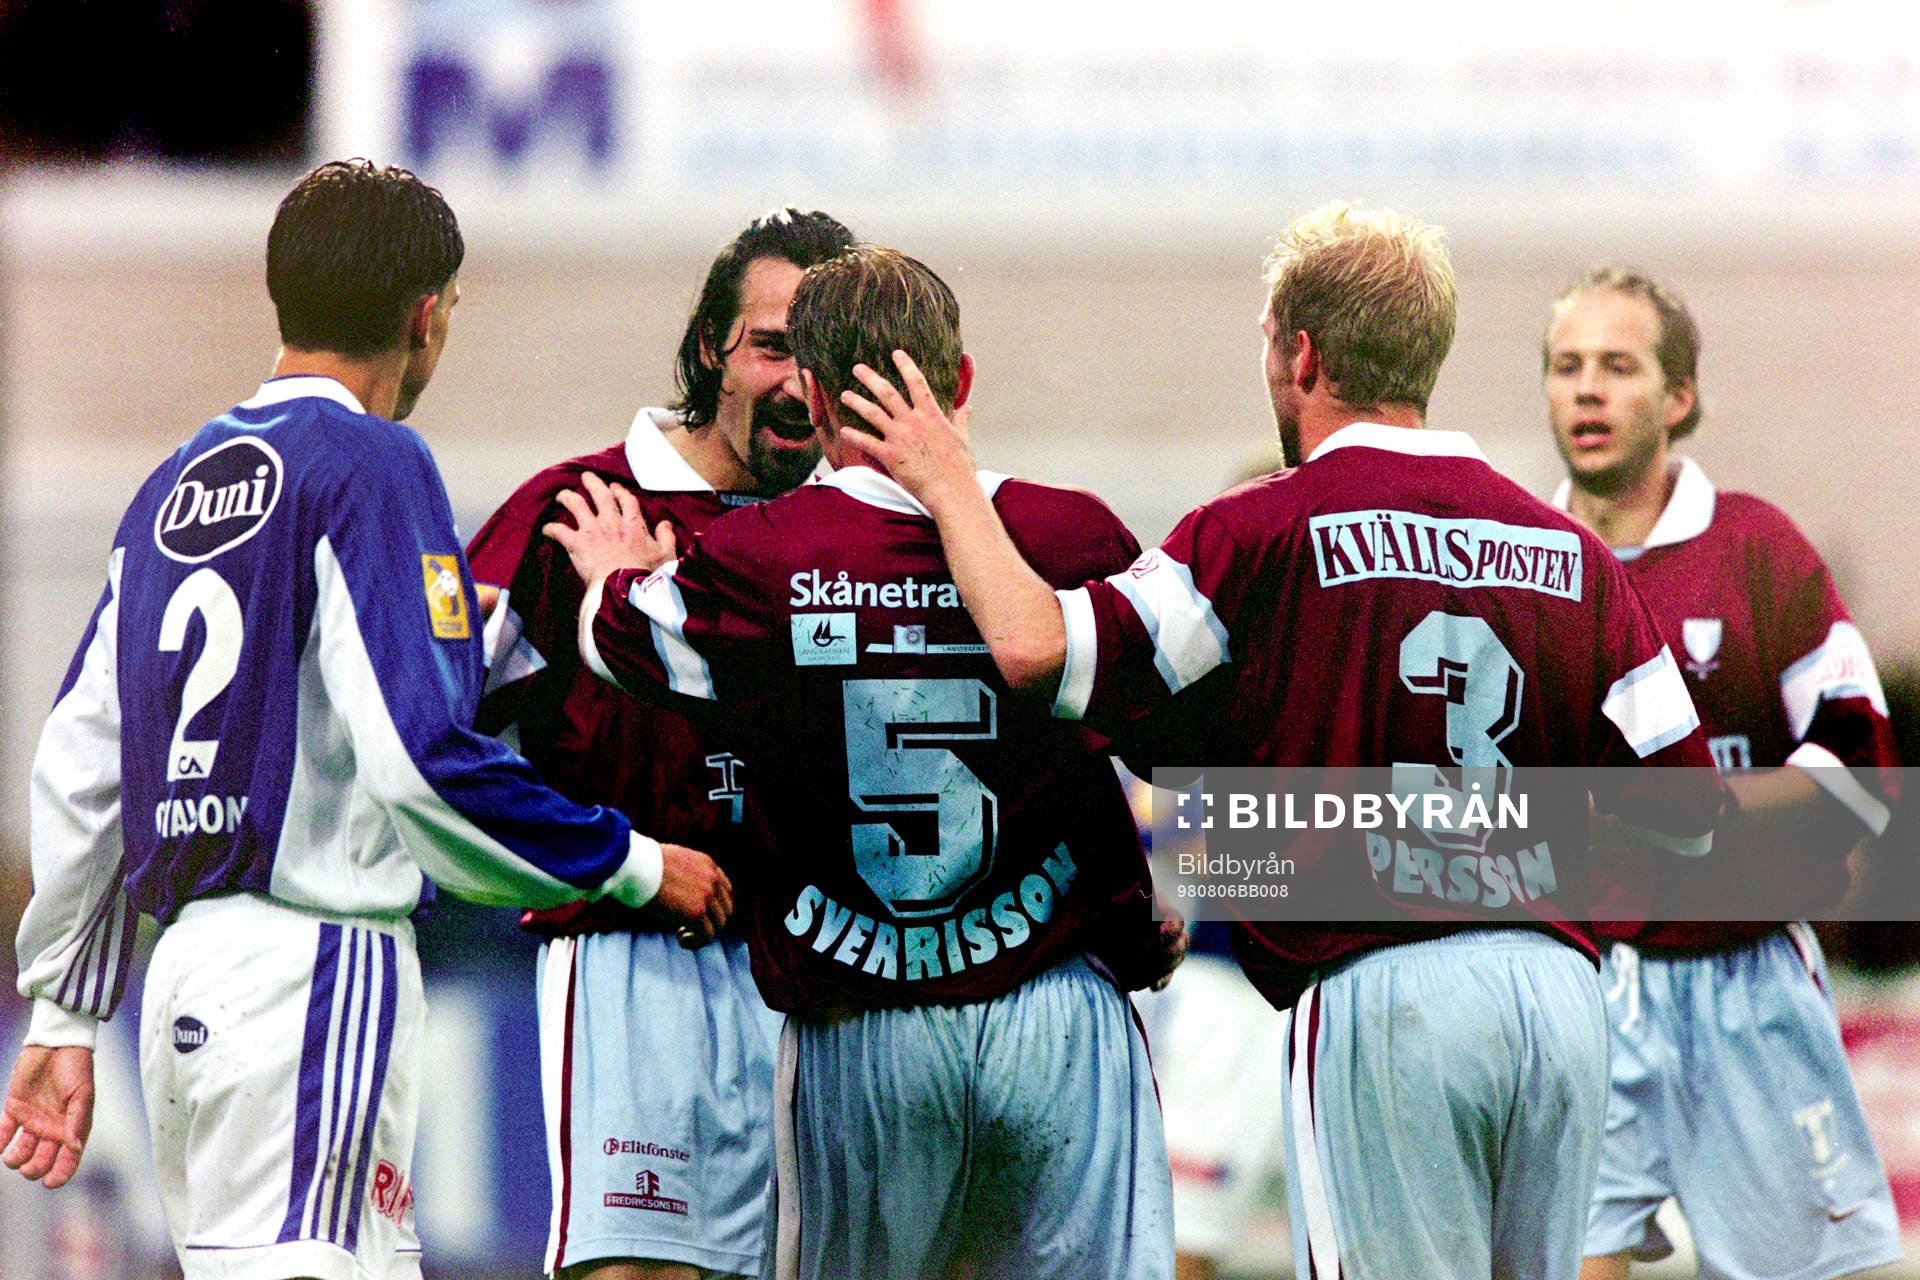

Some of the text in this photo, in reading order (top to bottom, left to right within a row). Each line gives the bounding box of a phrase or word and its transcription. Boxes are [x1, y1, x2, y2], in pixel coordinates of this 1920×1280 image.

[162, 464, 269, 534] Duni
[1315, 512, 1578, 593] KVÄLLSPOSTEN
[789, 568, 967, 609] Skånetra
[158, 567, 244, 782] 2
[1391, 610, 1525, 852] 3
[842, 678, 999, 918] 5
[784, 841, 1078, 981] SVERRISSON
